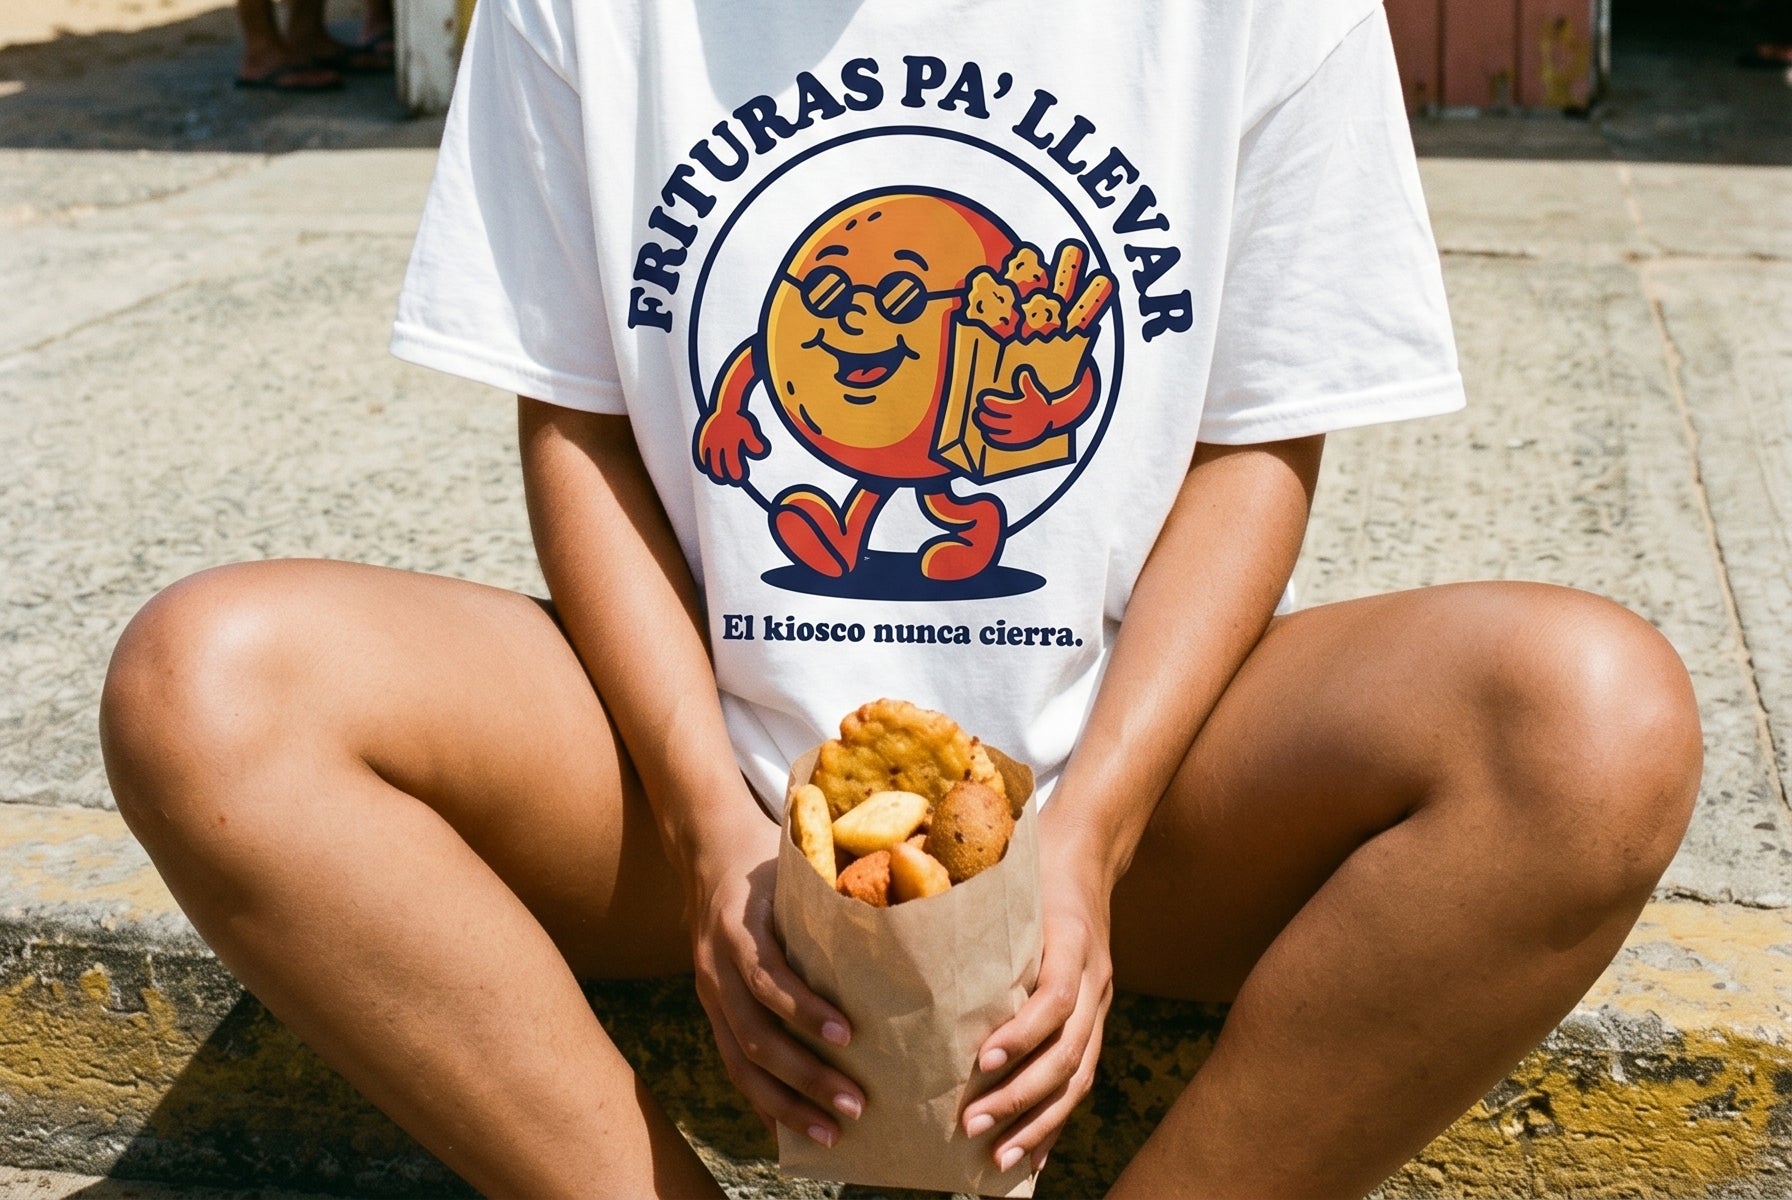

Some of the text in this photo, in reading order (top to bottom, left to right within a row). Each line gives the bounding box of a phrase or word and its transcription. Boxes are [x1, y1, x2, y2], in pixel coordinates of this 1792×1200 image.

[627, 56, 885, 333] FRITURAS
[1012, 88, 1195, 343] LLEVAR
[722, 614, 1084, 647] El kiosco nunca cierra.
